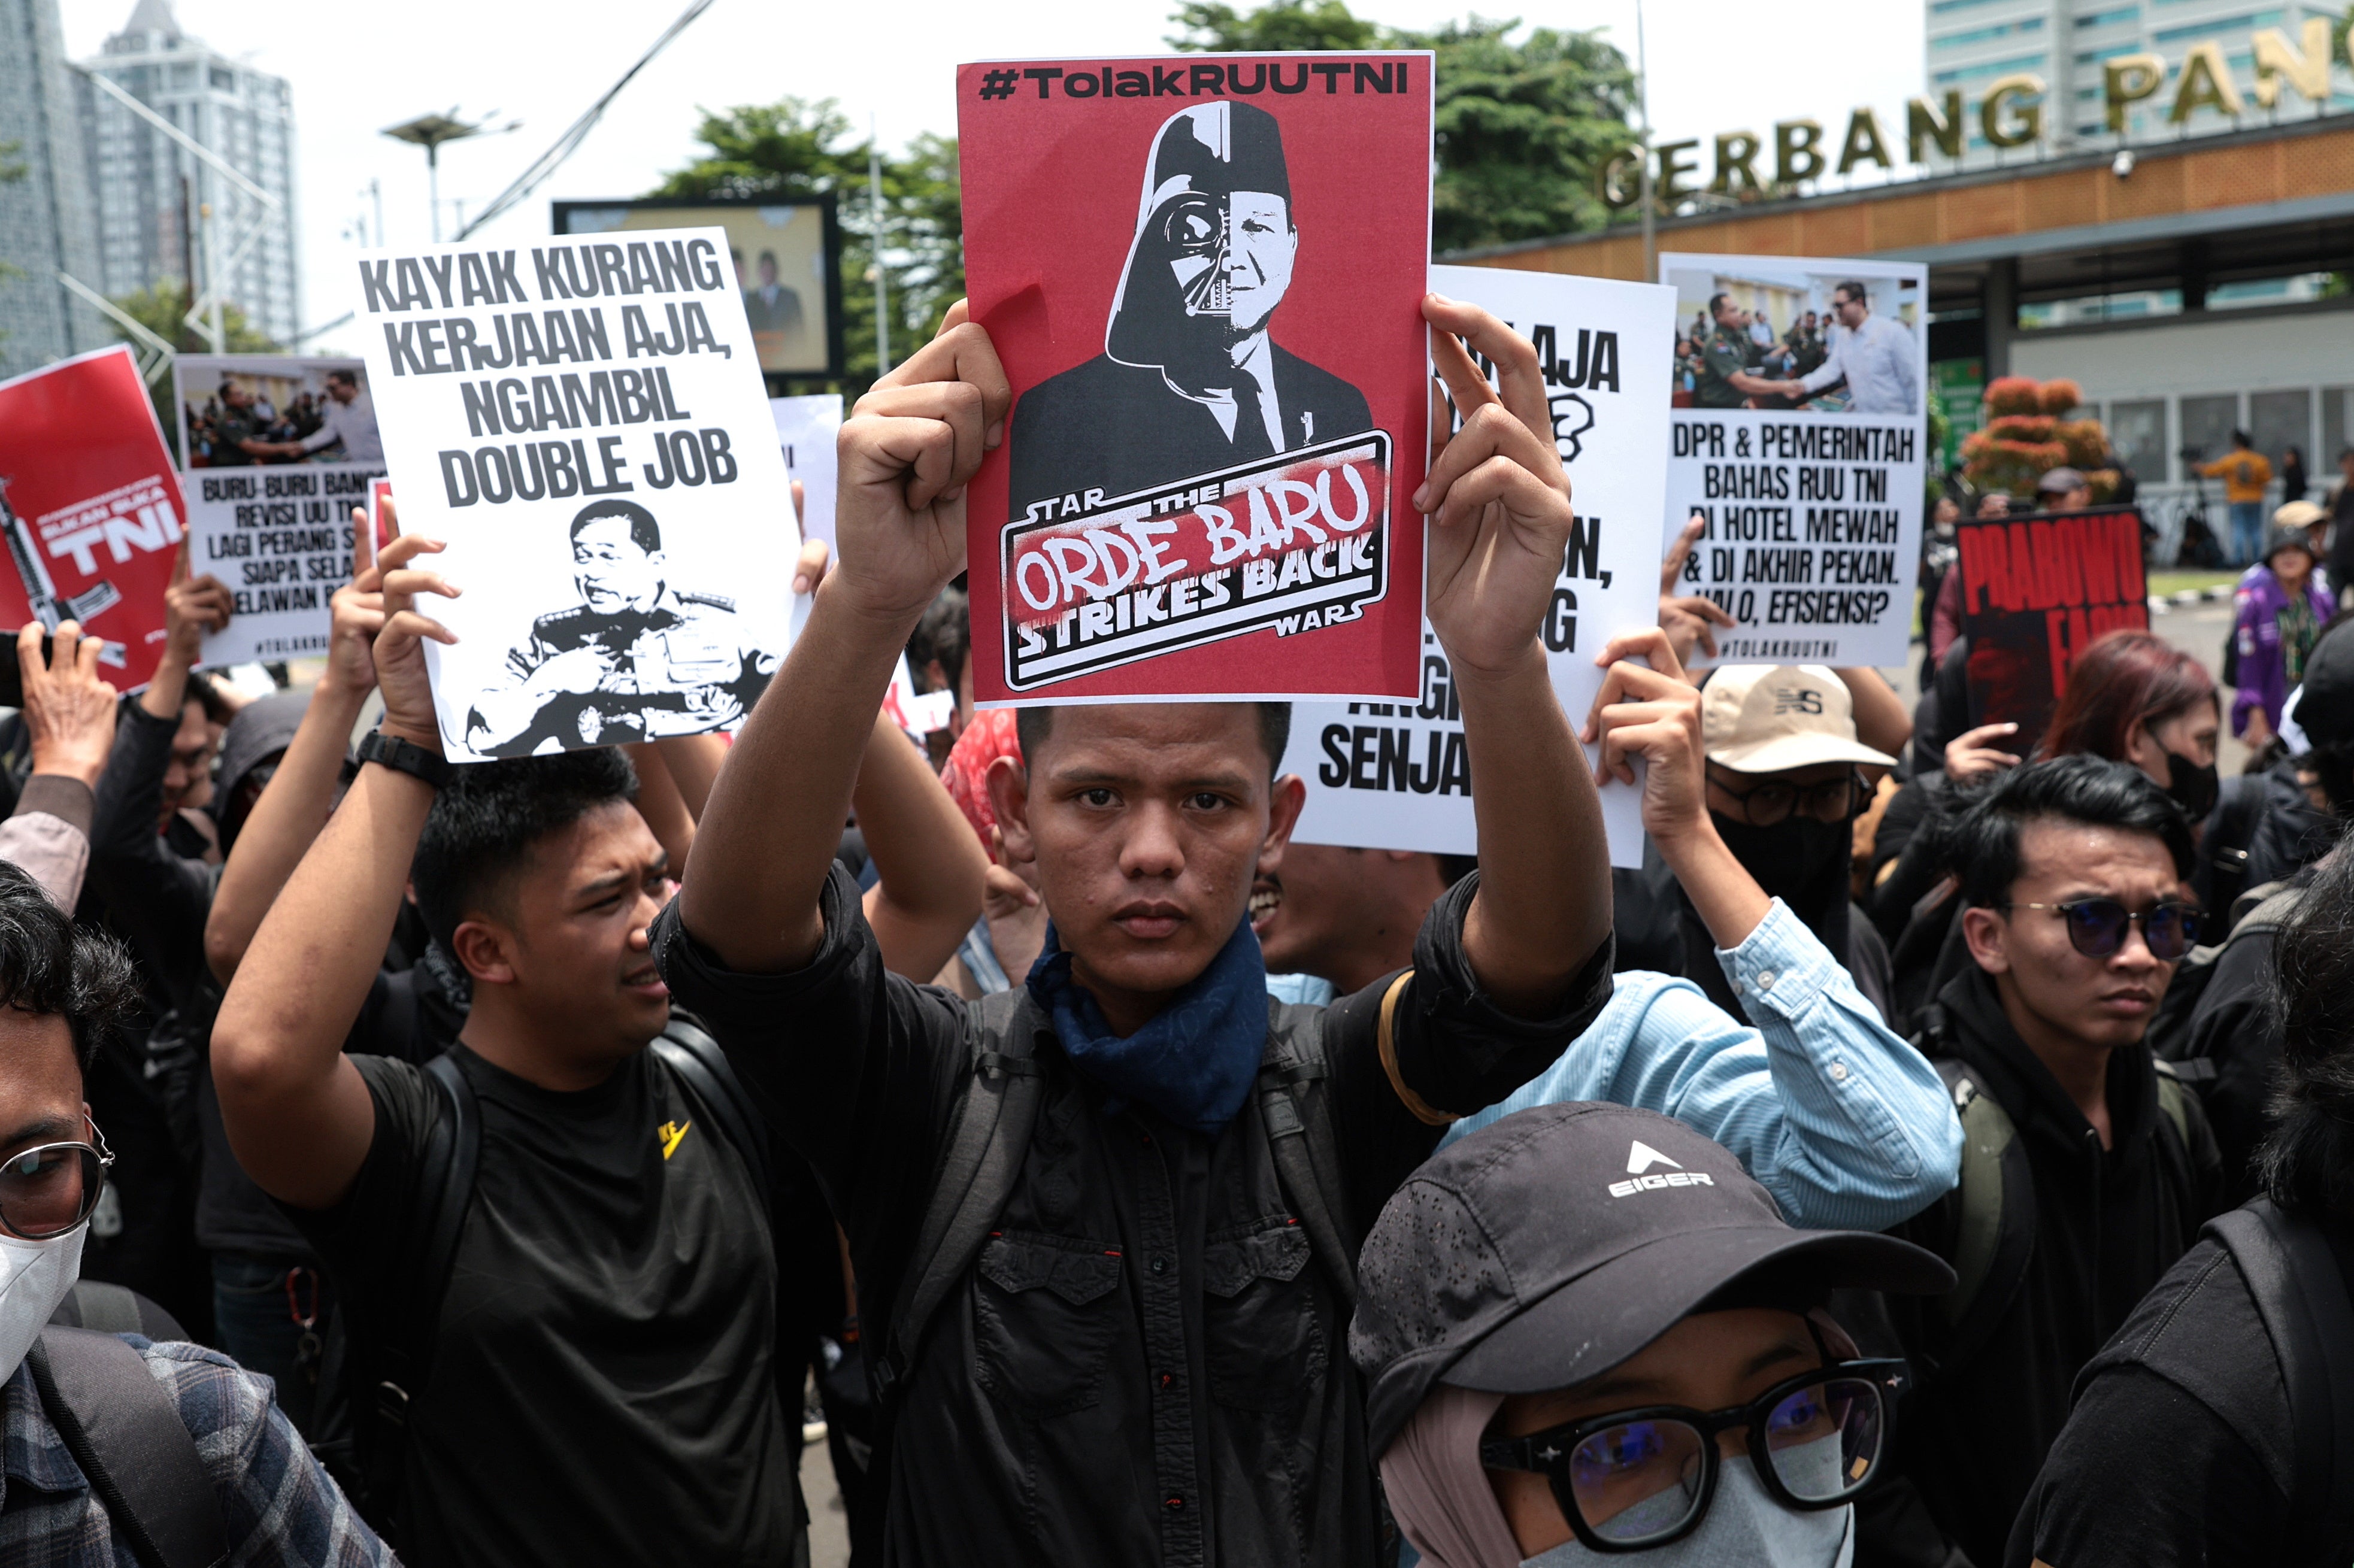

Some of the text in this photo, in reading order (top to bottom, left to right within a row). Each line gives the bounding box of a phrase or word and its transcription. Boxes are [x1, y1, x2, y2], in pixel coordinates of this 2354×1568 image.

[978, 62, 1407, 100] #TolakRUUTNI
[1595, 16, 2354, 210] GERBANG PAN
[359, 239, 725, 313] KAYAK KURANG
[383, 308, 613, 376] KERJAAN
[622, 302, 731, 360] AJA,
[461, 366, 691, 436] NGAMBIL
[1673, 423, 1914, 462] DPR & PEMERINTAH
[438, 428, 738, 507] DOUBLE JOB
[1704, 465, 1887, 503] BAHAS RUU TNI
[202, 473, 317, 501] BURU-BURU
[1026, 487, 1105, 523] STAR
[1153, 482, 1220, 517] THE
[235, 502, 296, 527] REVISI
[304, 501, 328, 523] UU
[1723, 507, 1796, 542] HOTEL
[1806, 508, 1899, 544] MEWAH
[47, 498, 183, 577] TNI
[208, 533, 252, 559] LAGI
[259, 528, 335, 554] PERANG
[1016, 463, 1369, 611] ORDE BARU
[242, 560, 299, 585] SIAPA
[1684, 548, 1899, 585] & DI AKHIR PEKAN.
[1958, 514, 2145, 616] PRABOWO
[1018, 532, 1374, 659] STRIKES BACK
[1768, 590, 1889, 626] EFISIENSI?
[1274, 604, 1364, 638] WARS
[1319, 723, 1472, 796] SENJA
[1608, 1172, 1714, 1197] EIGER
